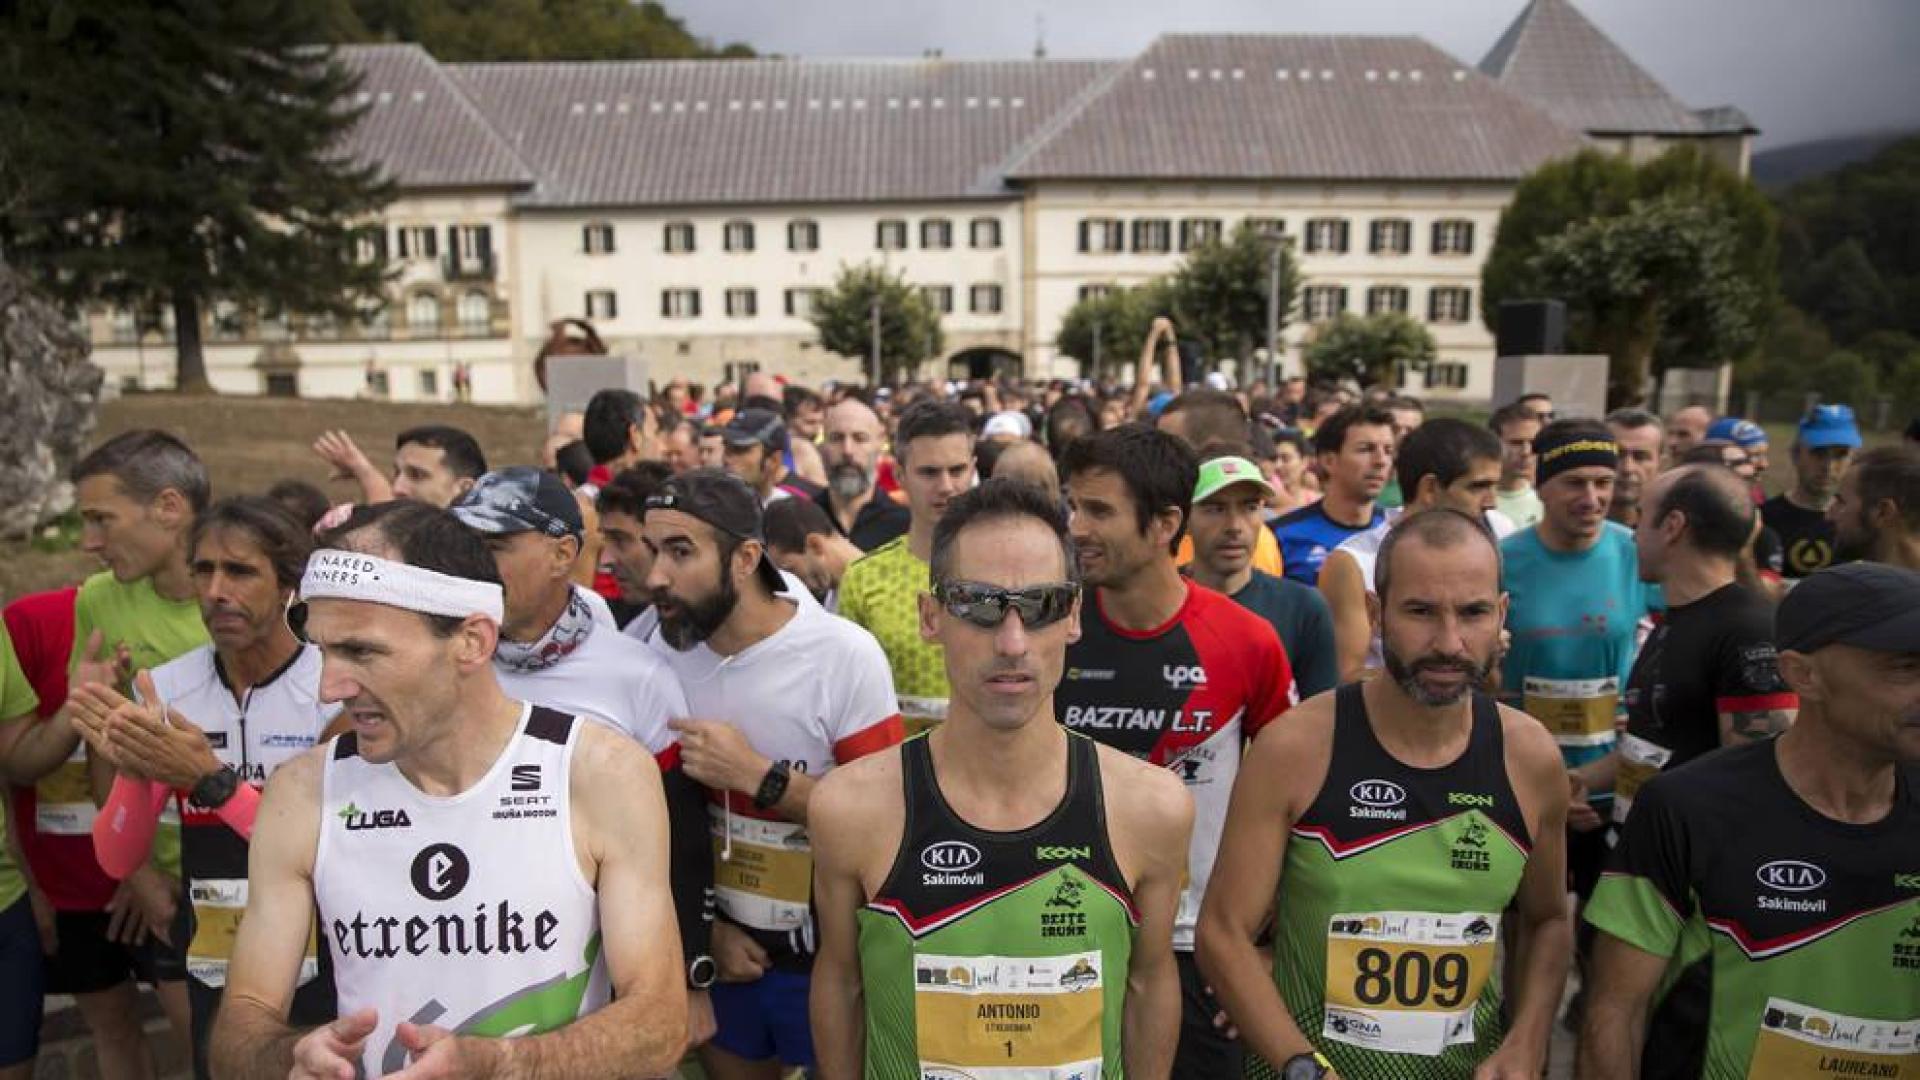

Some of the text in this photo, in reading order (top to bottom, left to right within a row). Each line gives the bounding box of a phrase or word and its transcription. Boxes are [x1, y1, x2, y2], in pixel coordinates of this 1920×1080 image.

[322, 555, 375, 573] NAKED
[1064, 706, 1213, 732] BAZTAN L.T.
[500, 796, 551, 805] SEAT
[1361, 787, 1397, 800] KIA
[931, 851, 971, 866] KIA
[923, 872, 984, 886] Sakimóvil
[1769, 869, 1815, 885] KIA
[1758, 896, 1826, 912] Sakimóvil
[333, 900, 559, 958] etxenike
[1354, 947, 1468, 1007] 809
[977, 1003, 1041, 1019] ANTONIO
[1003, 1040, 1013, 1058] 1
[1818, 1055, 1899, 1077] LAUREANO
